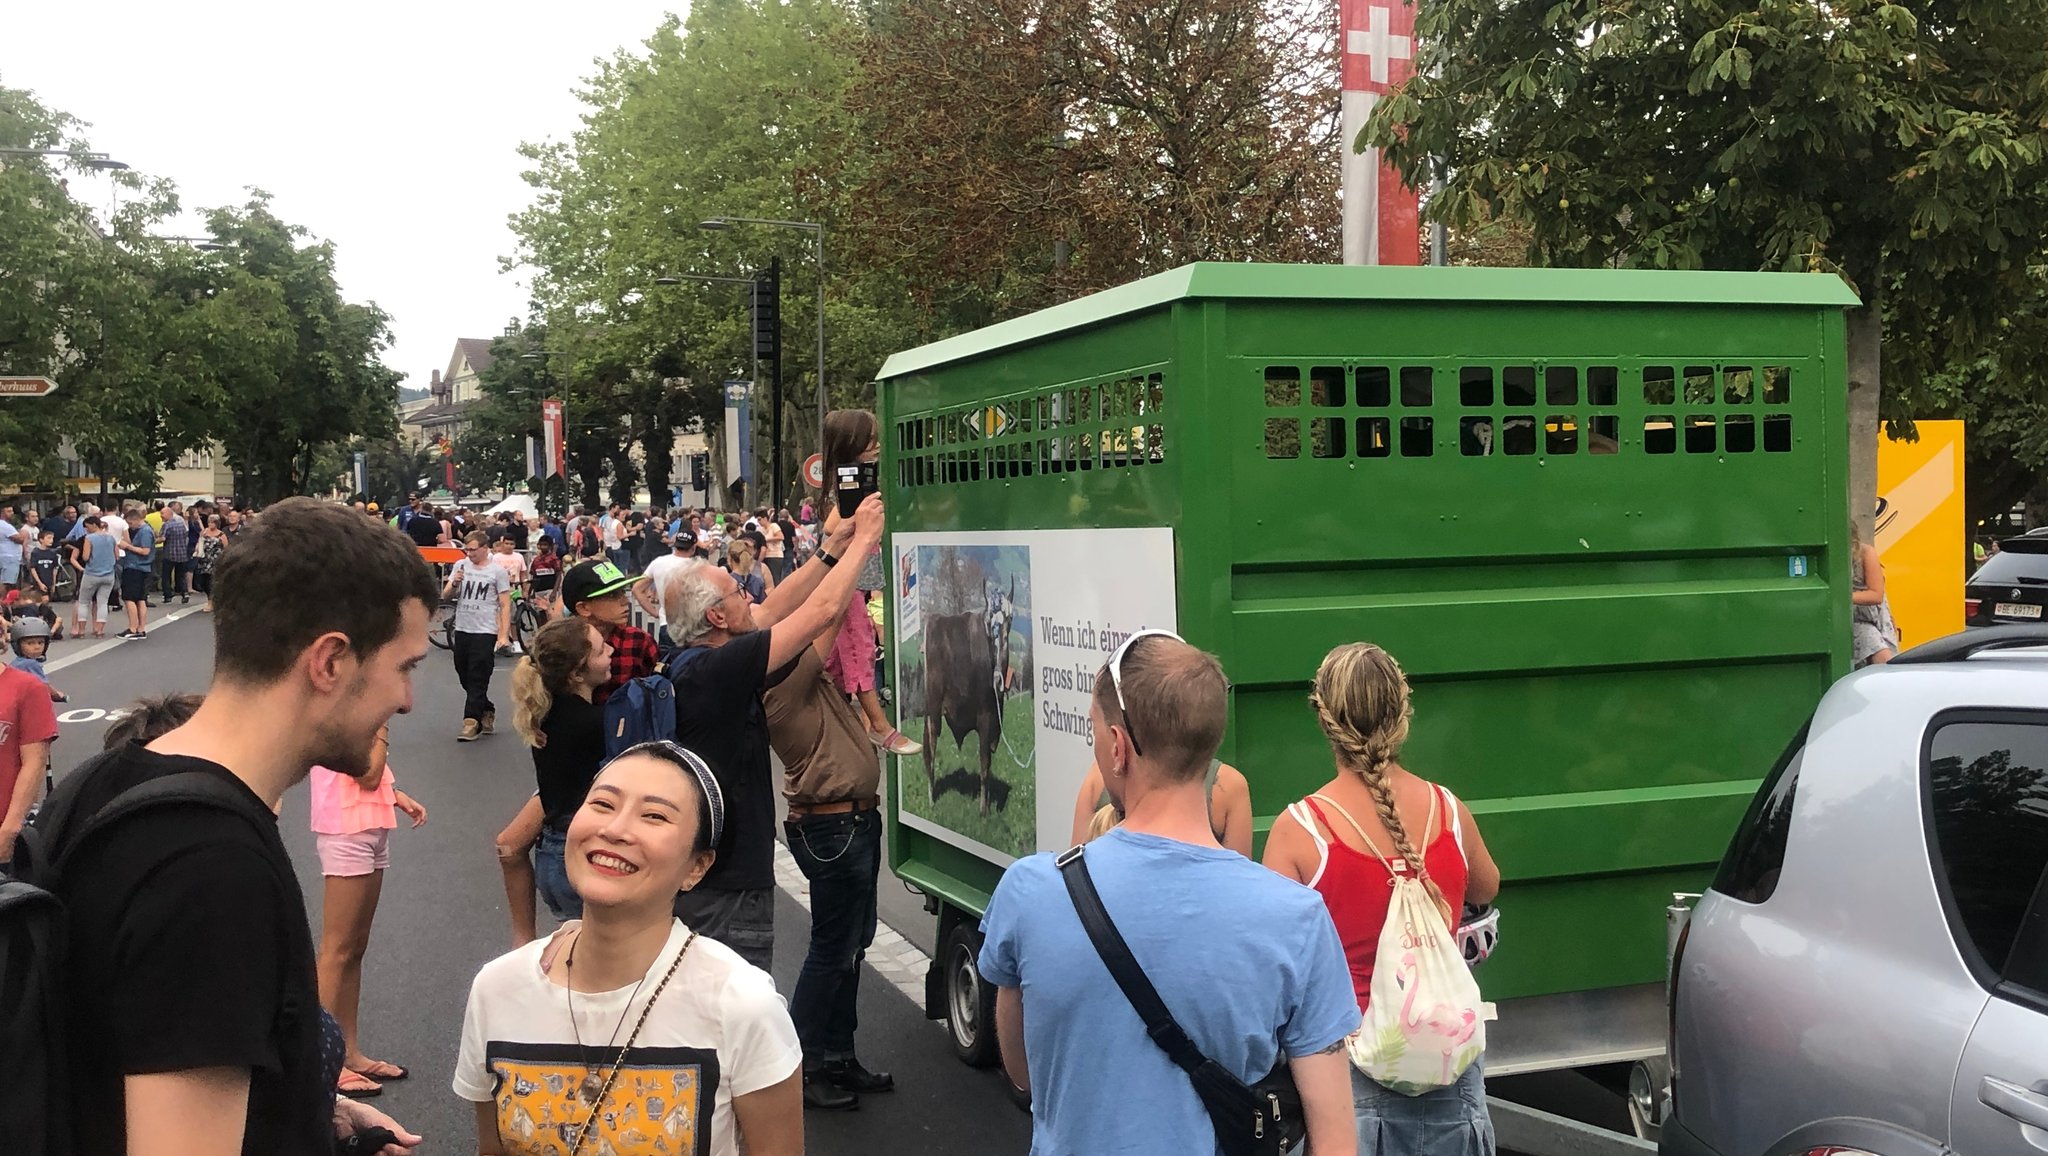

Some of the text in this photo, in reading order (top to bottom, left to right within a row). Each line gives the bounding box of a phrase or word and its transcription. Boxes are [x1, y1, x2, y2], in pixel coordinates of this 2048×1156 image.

[0, 381, 38, 392] berhuus
[1040, 616, 1075, 647] Wenn
[1077, 620, 1096, 650] ich
[1042, 663, 1095, 694] gross bin
[1043, 700, 1093, 746] Schwing
